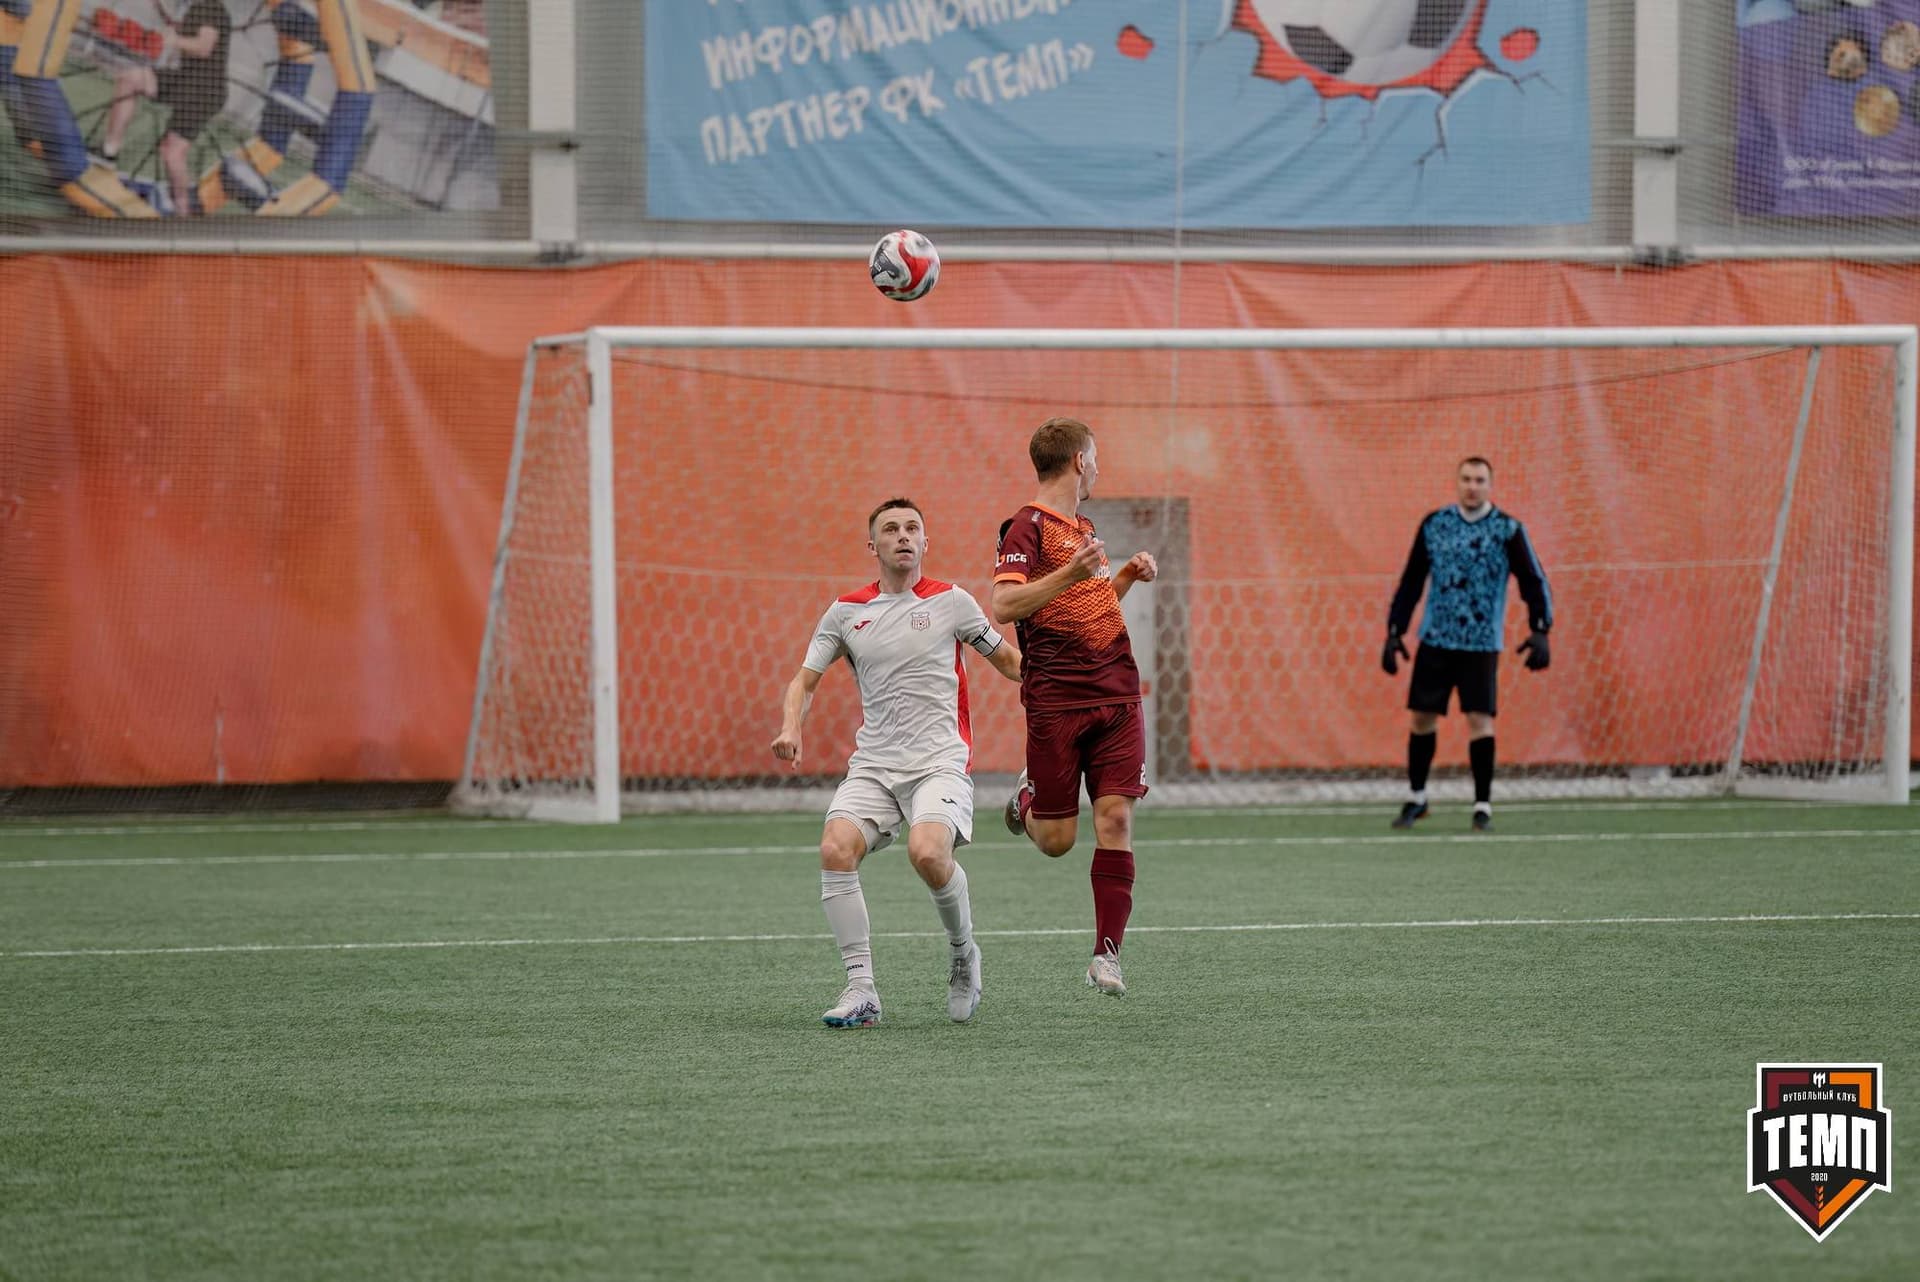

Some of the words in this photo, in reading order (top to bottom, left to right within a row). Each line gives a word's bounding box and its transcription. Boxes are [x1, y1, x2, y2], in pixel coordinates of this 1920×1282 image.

[701, 84, 870, 164] ПАРТНЕР
[880, 66, 946, 124] ФК
[954, 38, 1094, 105] «ТЕМП»
[1006, 552, 1028, 564] ПСБ
